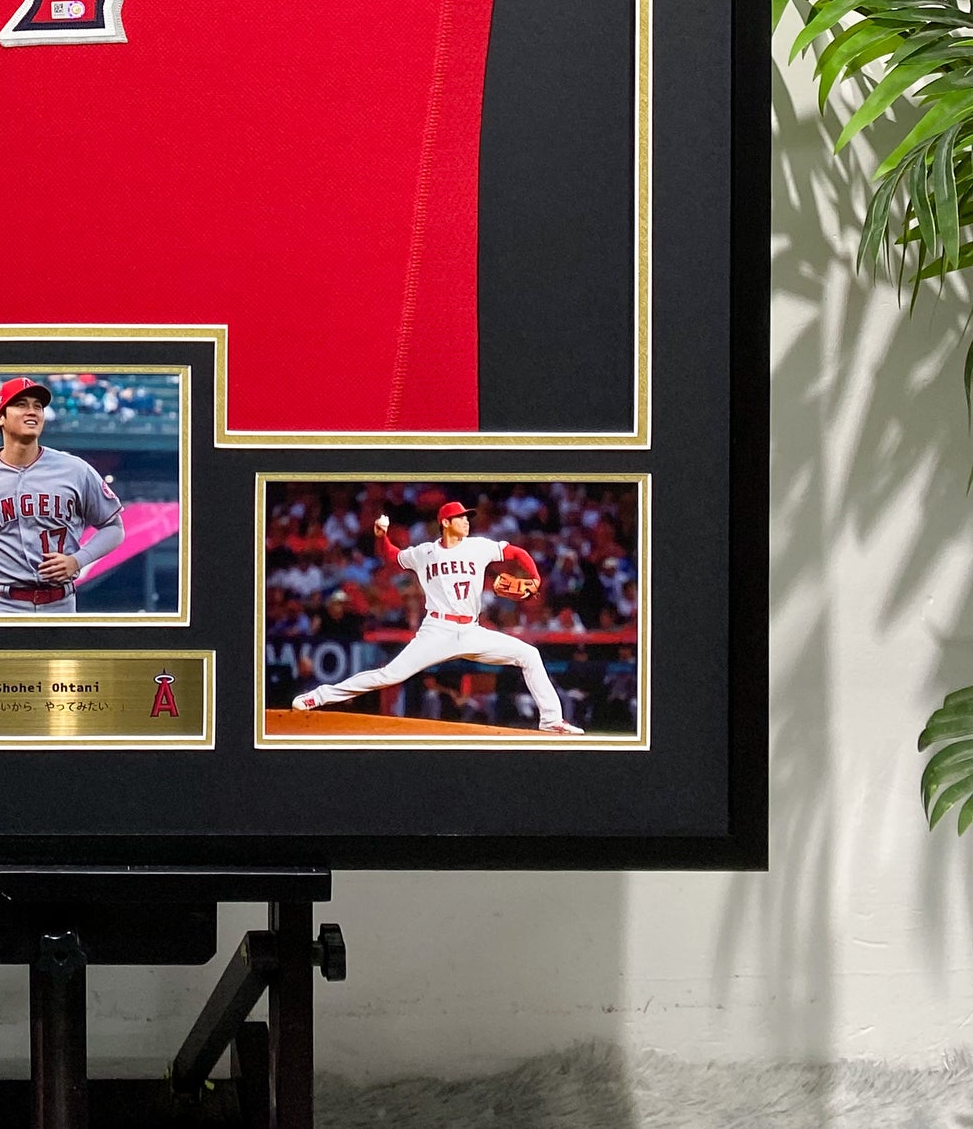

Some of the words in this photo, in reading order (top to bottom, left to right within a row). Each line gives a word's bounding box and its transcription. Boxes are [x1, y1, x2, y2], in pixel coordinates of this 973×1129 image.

[38, 526, 68, 561] 17
[425, 560, 476, 584] ANGELS
[453, 580, 471, 600] 17
[51, 681, 100, 693] Ohtani
